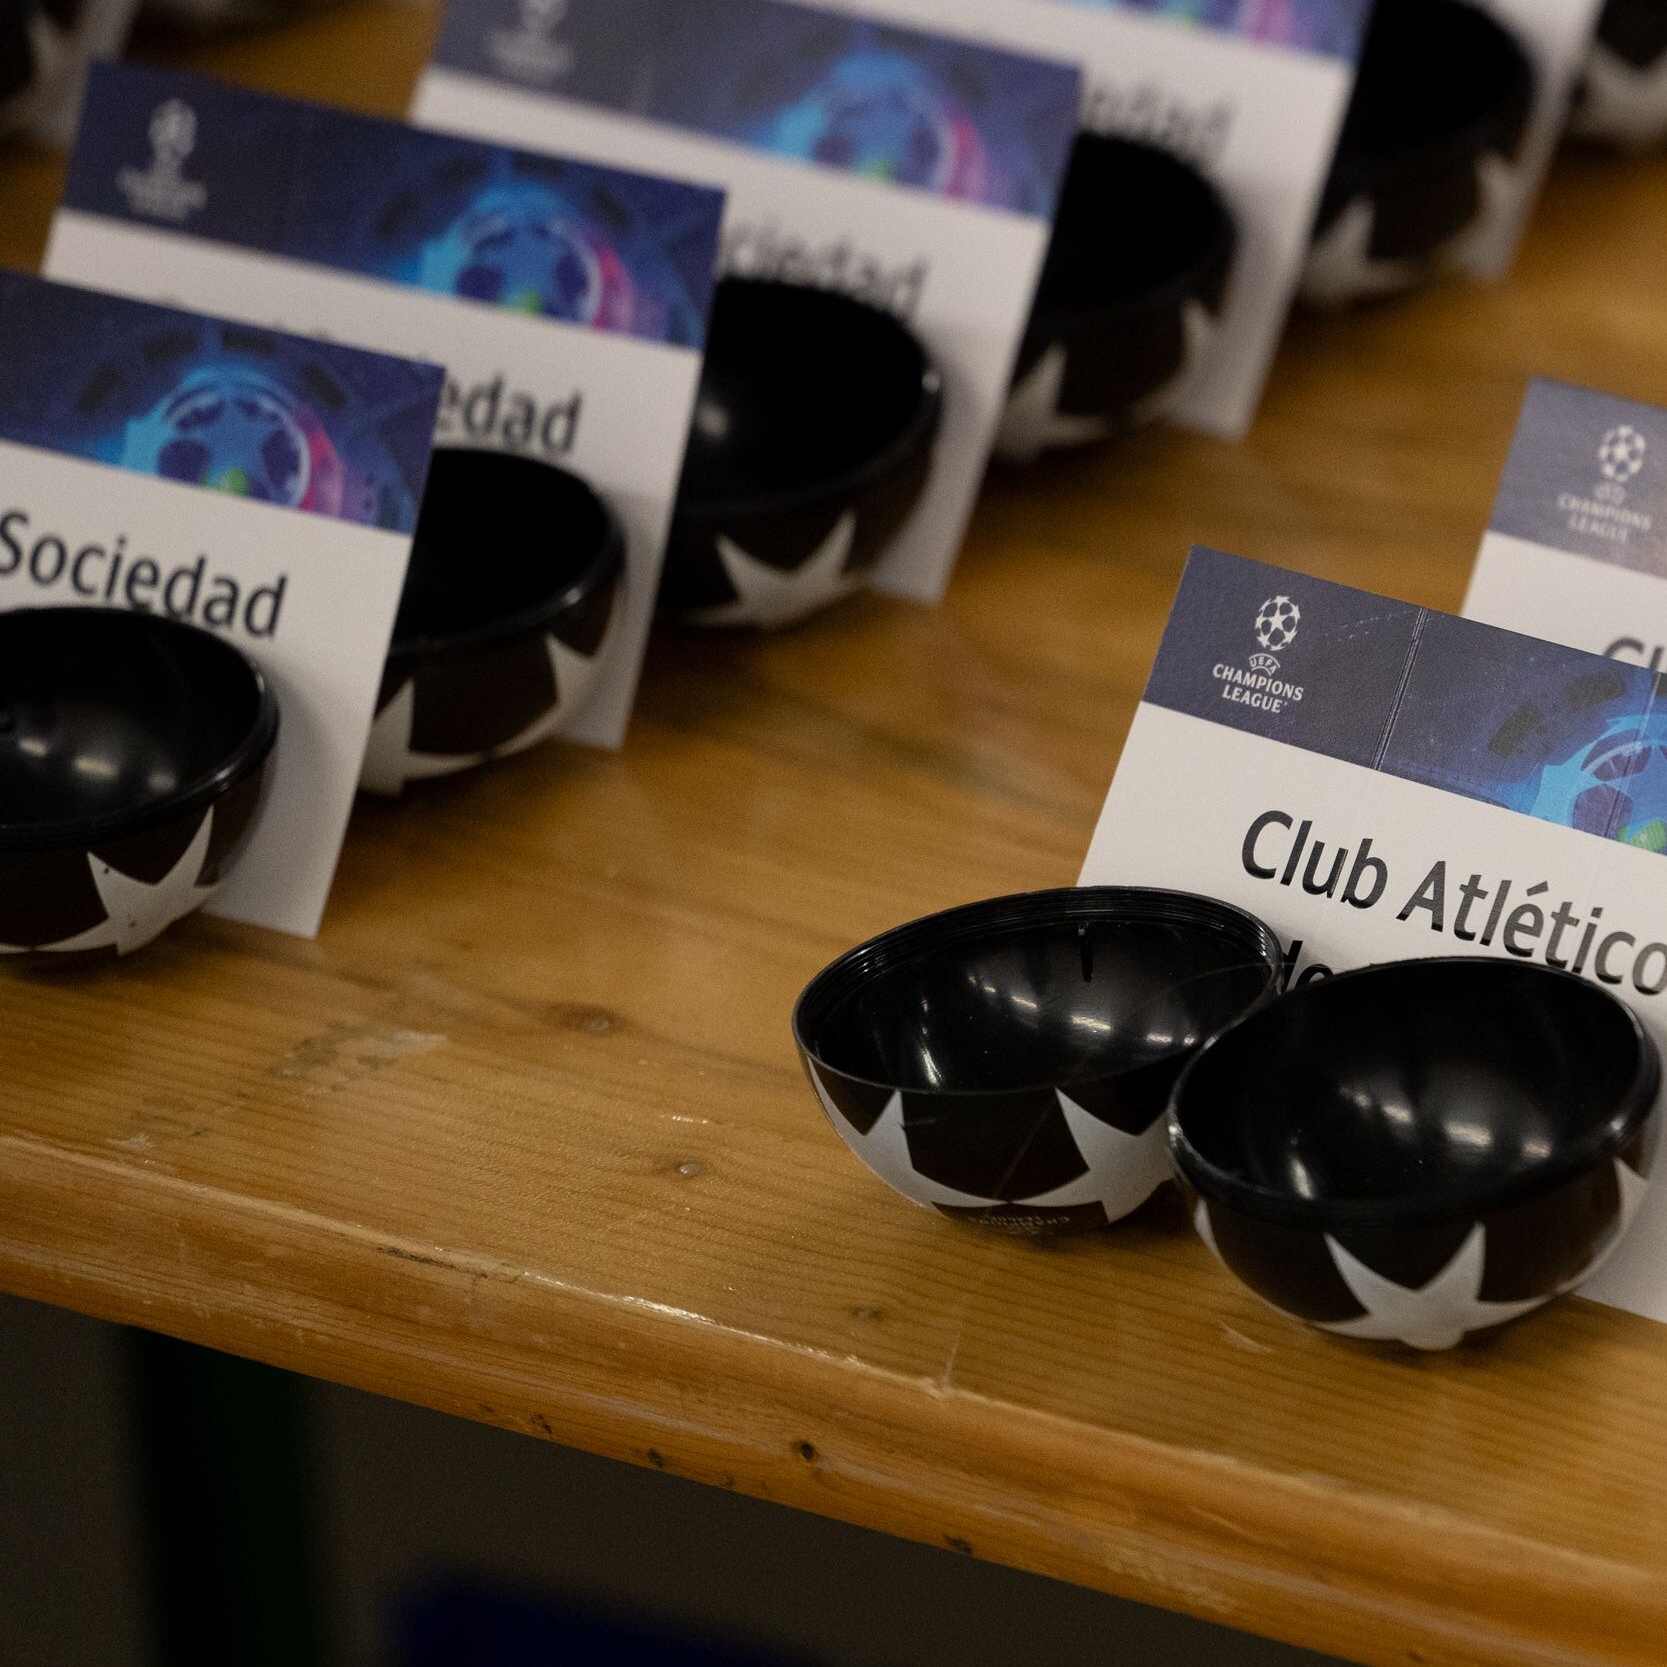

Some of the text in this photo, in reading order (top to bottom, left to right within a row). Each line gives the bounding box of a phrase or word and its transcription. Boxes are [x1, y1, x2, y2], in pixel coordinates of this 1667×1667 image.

[0, 508, 289, 638] Sociedad
[1212, 663, 1304, 701] CHAMPIONS
[1249, 655, 1279, 676] UEFA
[1222, 684, 1283, 714] LEAGUE
[1241, 810, 1388, 910] Club
